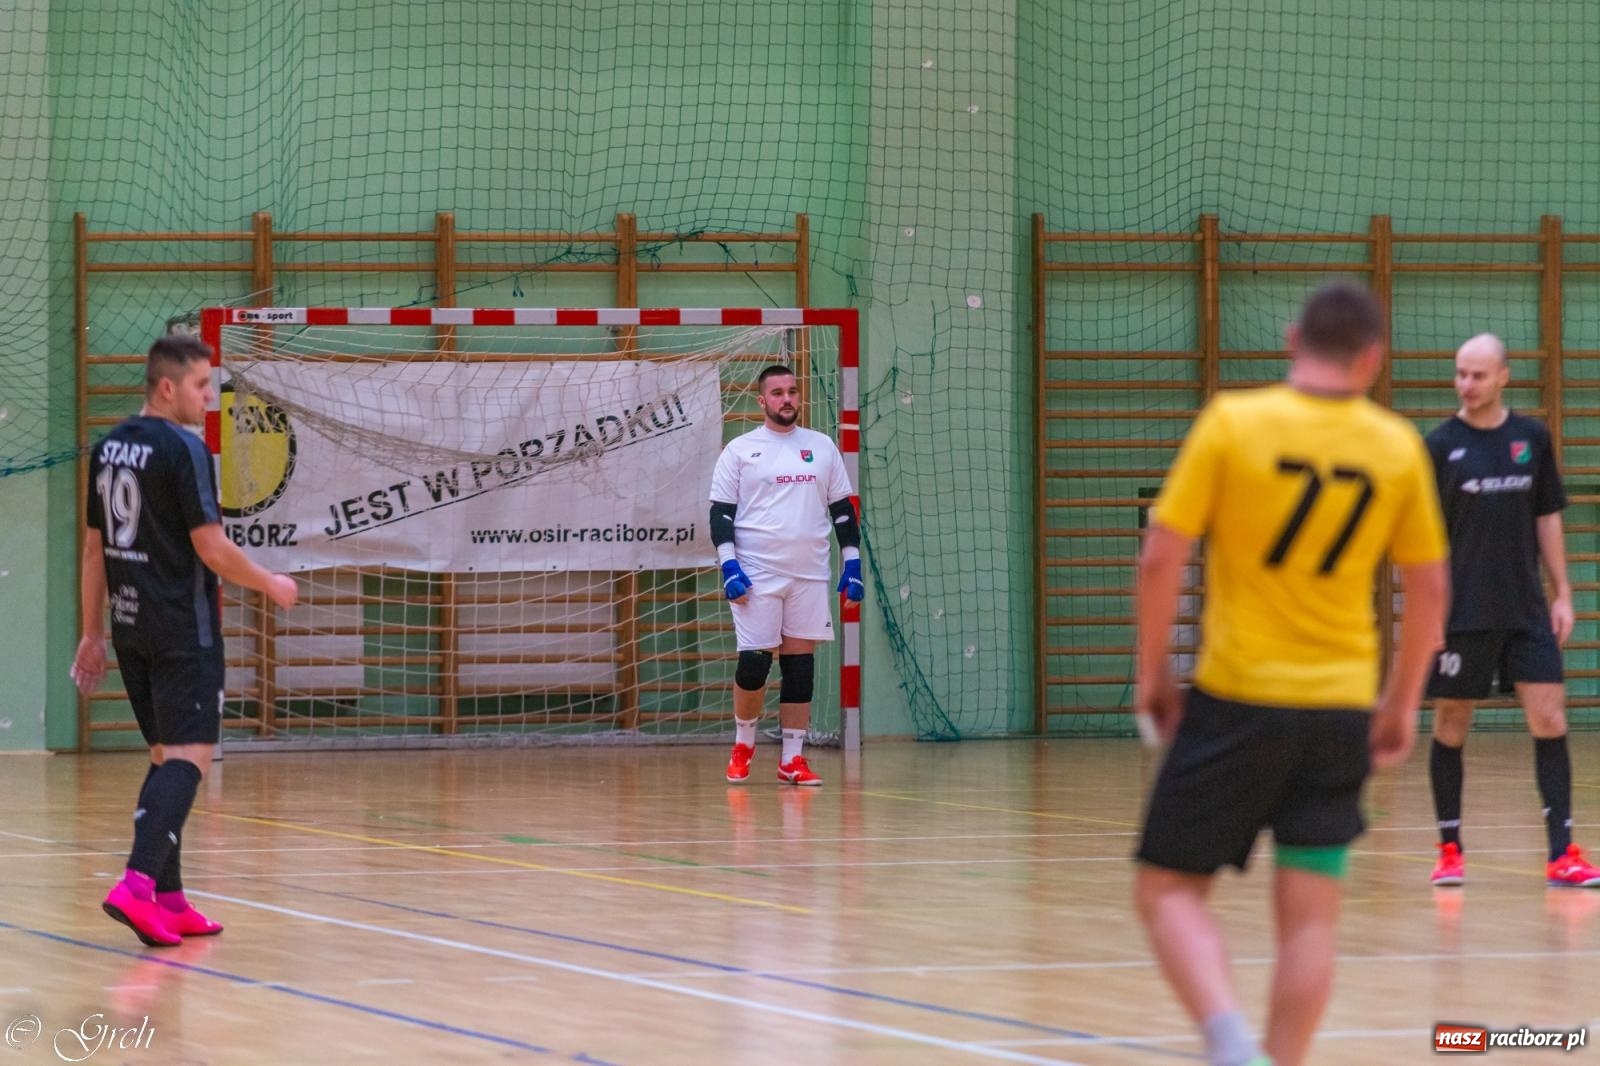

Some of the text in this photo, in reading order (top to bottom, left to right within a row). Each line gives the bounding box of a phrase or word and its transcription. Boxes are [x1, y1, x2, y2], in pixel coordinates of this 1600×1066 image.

[267, 312, 294, 321] sport
[100, 440, 153, 469] START
[776, 474, 817, 484] SOLIDUM
[96, 464, 142, 548] 19
[324, 481, 411, 536] JEST
[422, 468, 460, 503] W
[1266, 458, 1374, 577] 77
[470, 523, 695, 546] www.osir-raciborz.pl
[1439, 651, 1462, 677] 10
